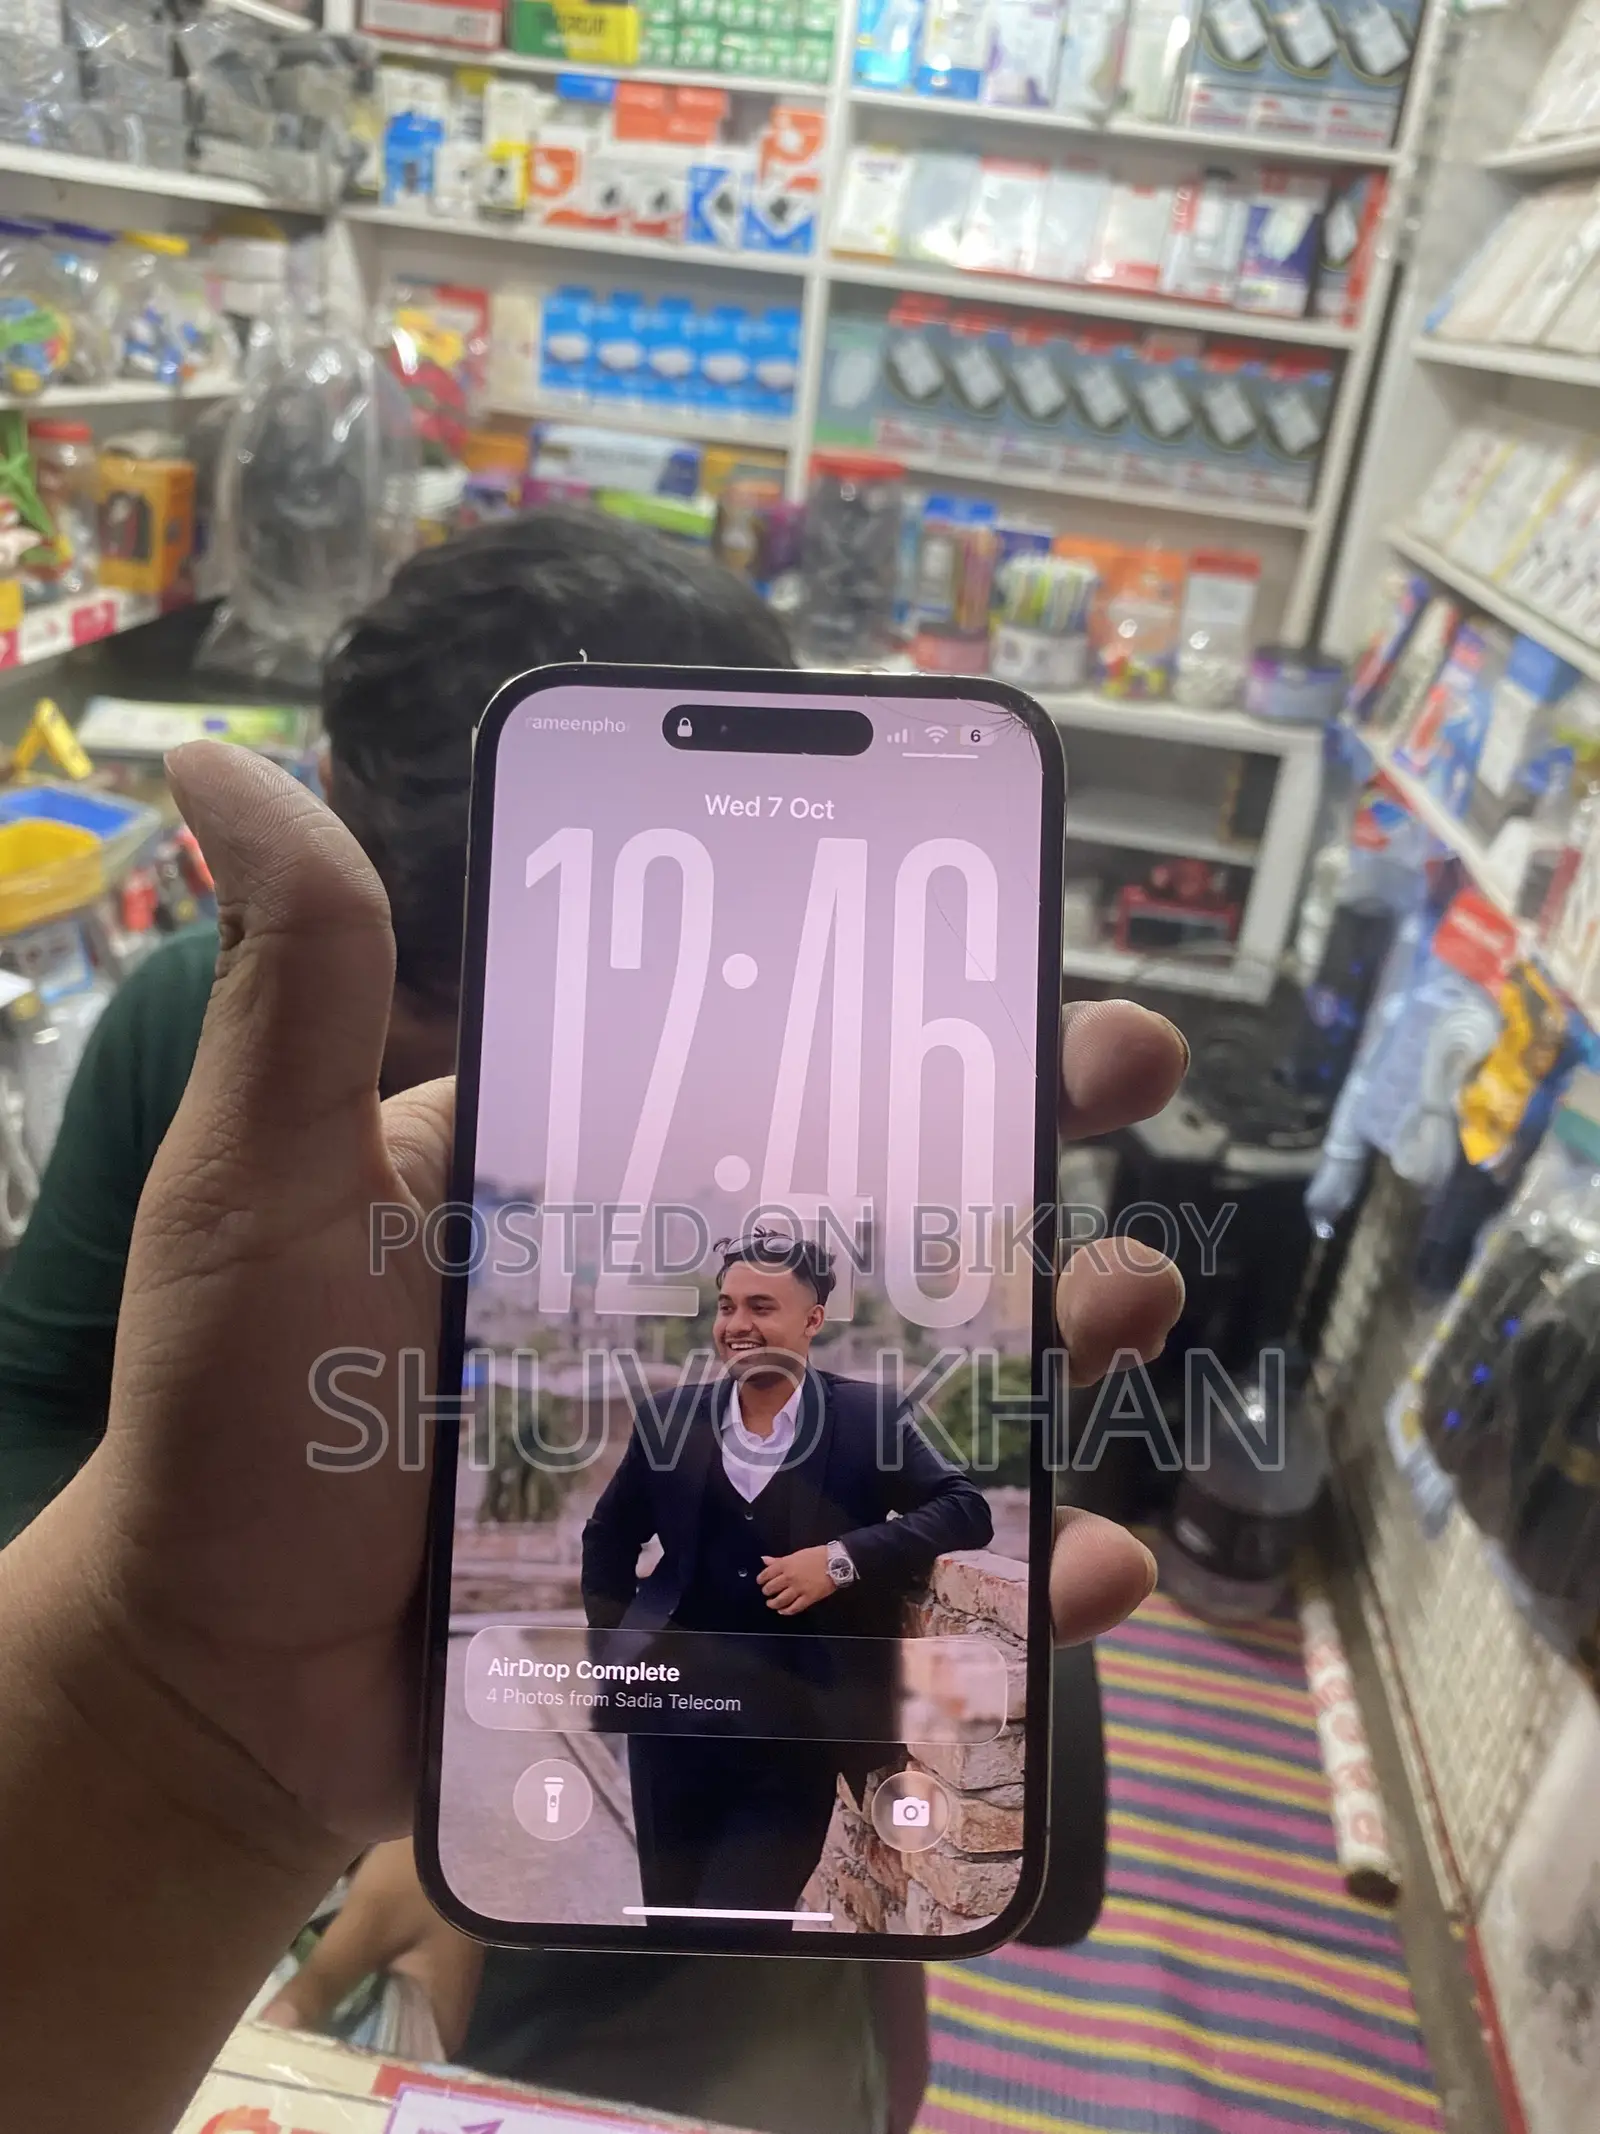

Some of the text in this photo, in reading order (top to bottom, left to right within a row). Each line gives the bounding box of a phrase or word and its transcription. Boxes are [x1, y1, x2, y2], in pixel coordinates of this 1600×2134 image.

[970, 729, 981, 743] 6
[704, 793, 835, 820] Wed 7 Oct
[525, 827, 999, 1328] 12:46
[487, 1656, 681, 1685] AirDrop Complete
[486, 1687, 742, 1712] 4 Photos from Sadia Telecom
